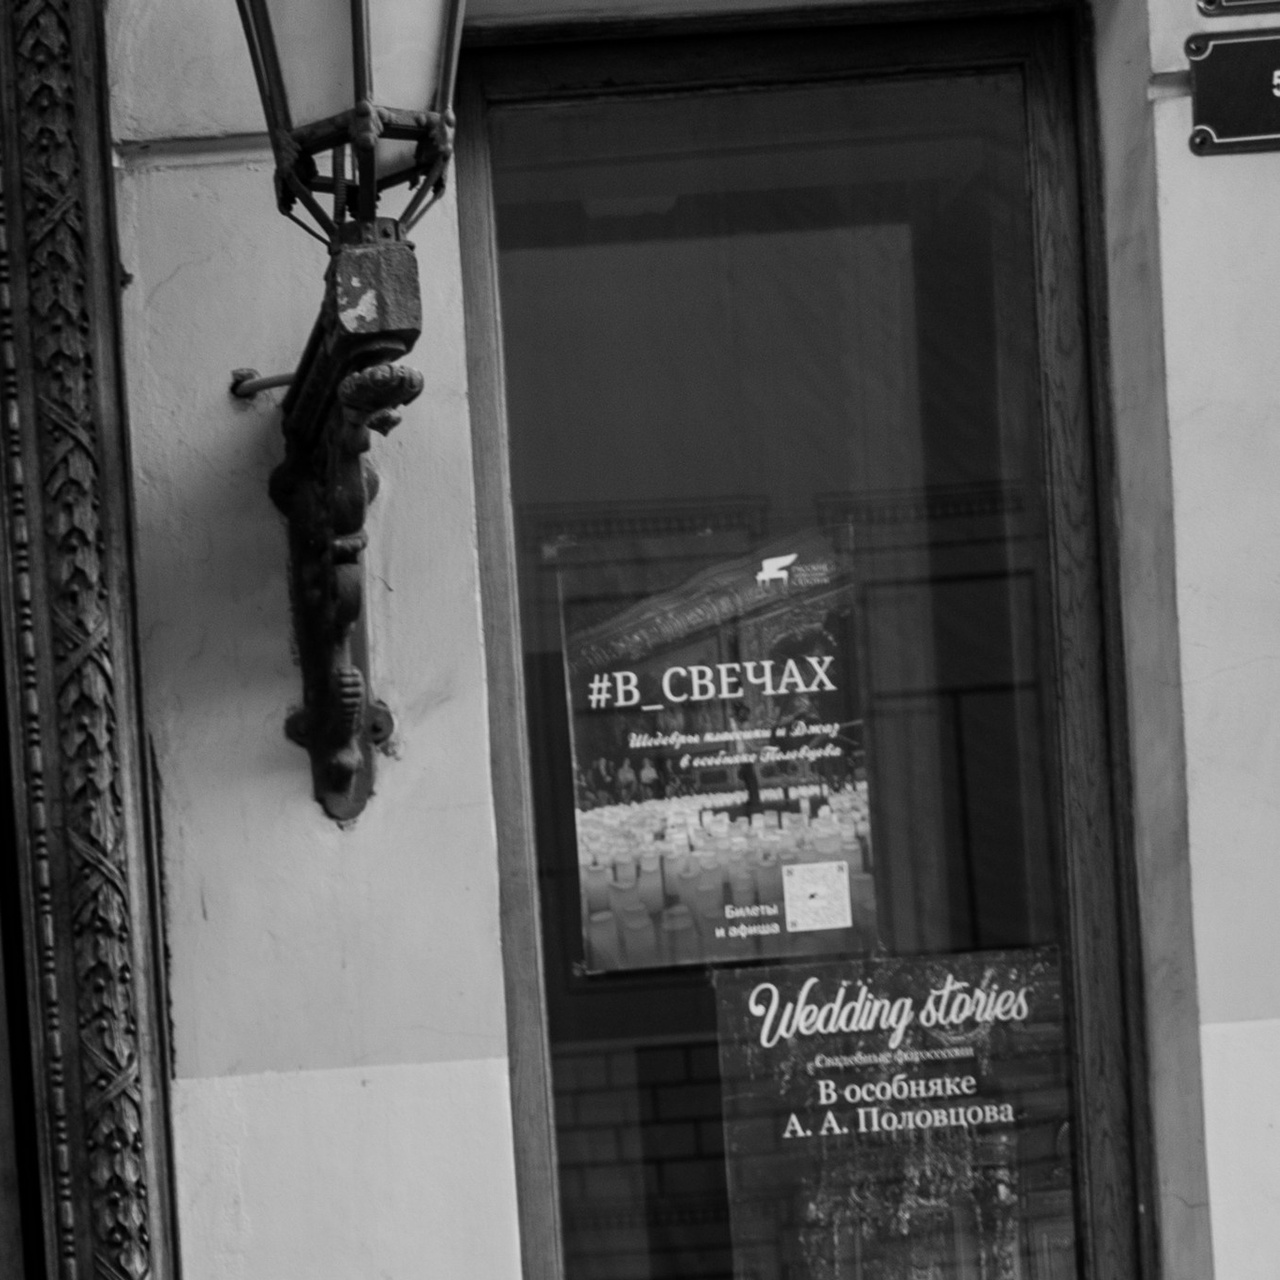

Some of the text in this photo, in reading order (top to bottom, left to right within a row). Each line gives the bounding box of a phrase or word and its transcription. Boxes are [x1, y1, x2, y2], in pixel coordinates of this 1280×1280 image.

[588, 655, 838, 710] #В_СВЕЧАХ
[724, 903, 779, 919] Билеты
[714, 922, 780, 939] и афиша
[749, 973, 1029, 1050] Wedding stories
[817, 1073, 977, 1105] В особняке
[782, 1102, 1015, 1139] А. А. Половцова
